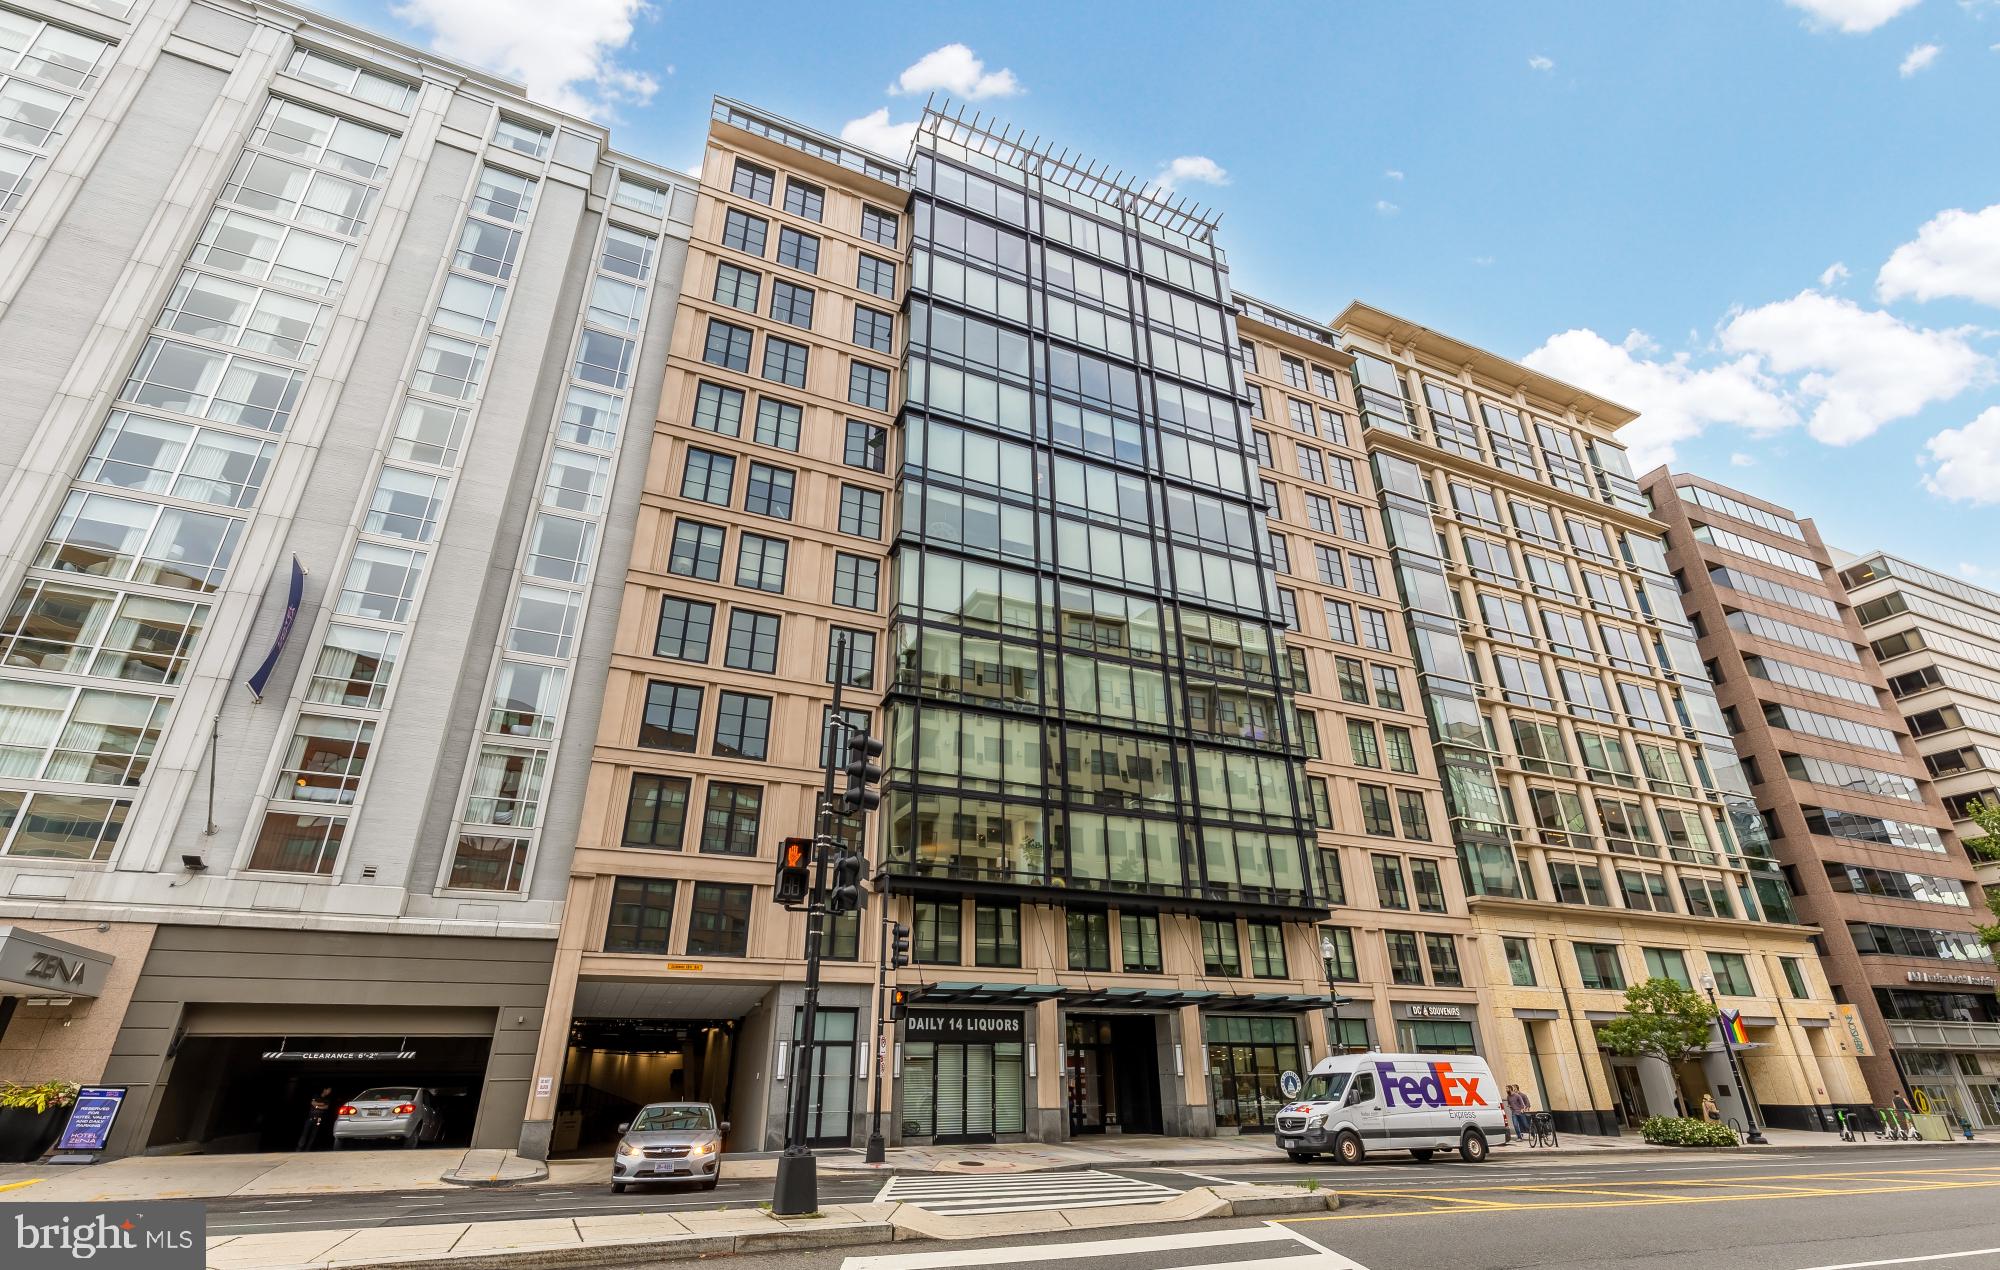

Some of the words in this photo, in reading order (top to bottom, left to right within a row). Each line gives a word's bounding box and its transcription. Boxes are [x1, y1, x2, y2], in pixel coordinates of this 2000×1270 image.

[25, 952, 85, 985] ZENA
[908, 1017, 944, 1030] DAILY
[949, 1018, 962, 1030] 14
[967, 1018, 1019, 1031] LIQUORS
[1375, 1062, 1488, 1108] FedEx
[1449, 1109, 1477, 1120] Express
